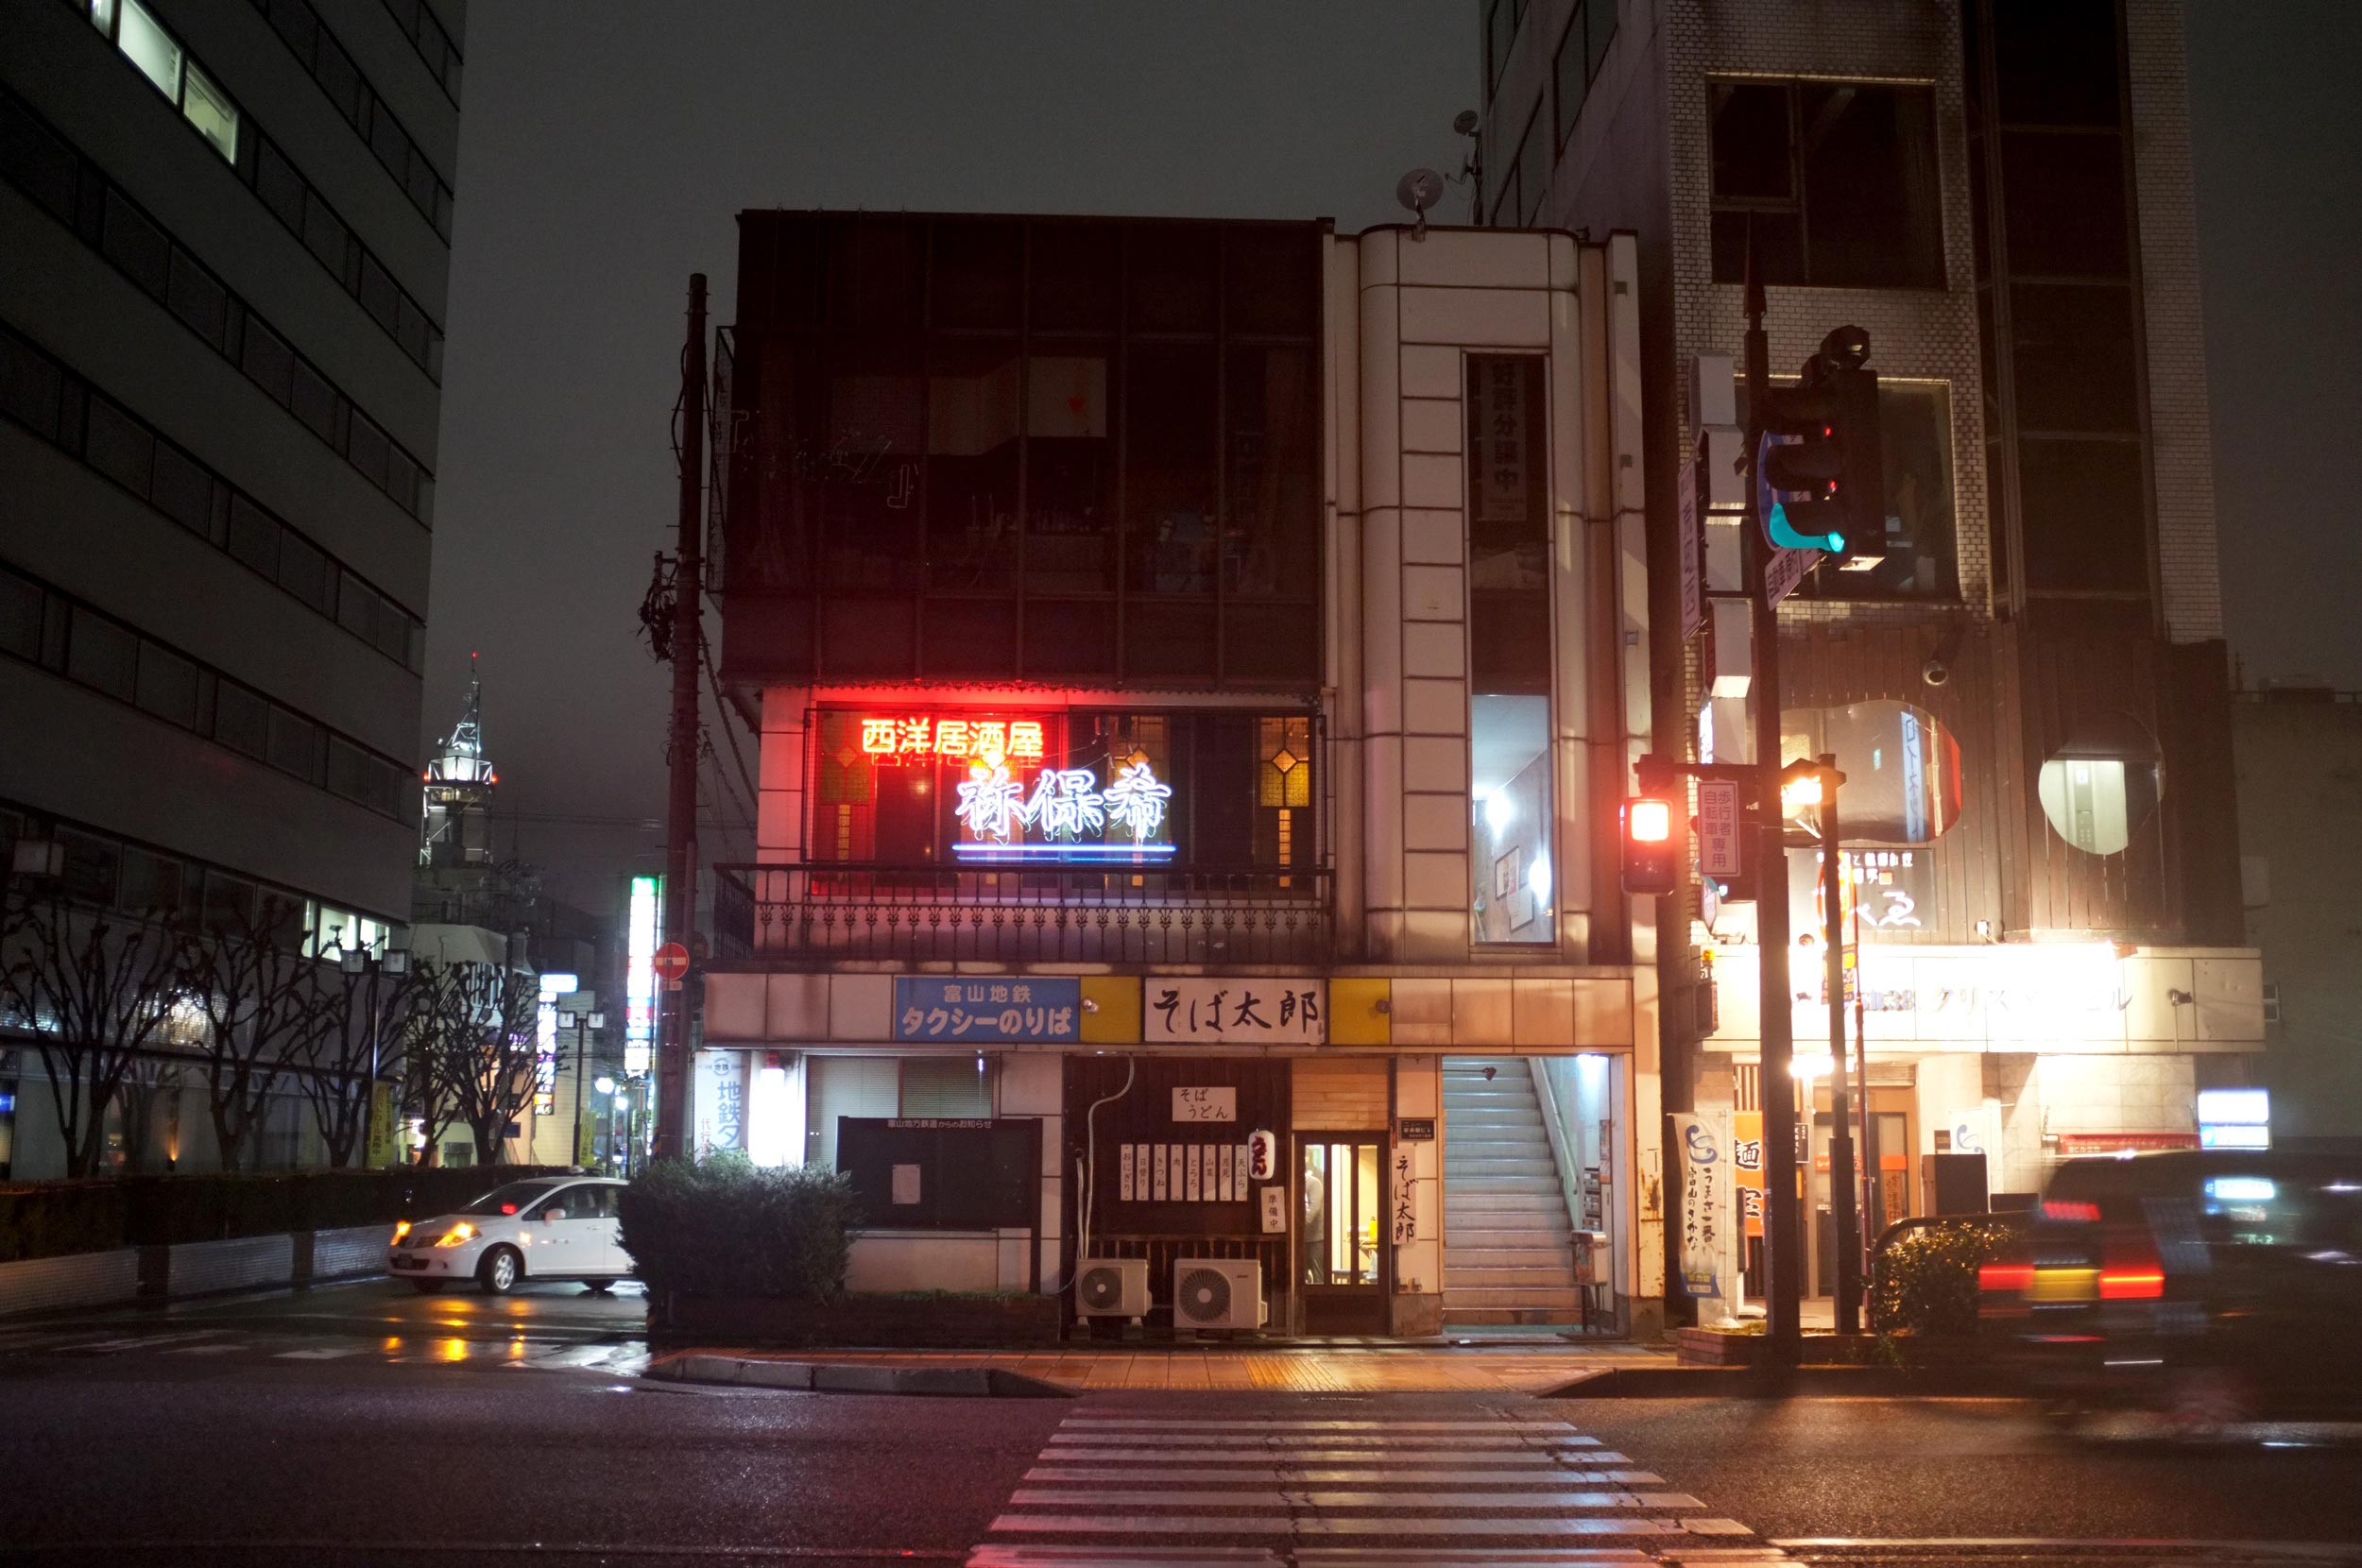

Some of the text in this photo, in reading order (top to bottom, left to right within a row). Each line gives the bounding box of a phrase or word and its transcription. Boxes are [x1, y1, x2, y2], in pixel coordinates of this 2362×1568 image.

[861, 716, 1044, 758] 西洋居酒屋
[1703, 791, 1719, 836] 自転車
[1718, 791, 1732, 836] 歩行者
[1711, 838, 1727, 868] 専用
[943, 983, 1032, 1004] 富山地鉄
[1931, 985, 2134, 1013] クリスル
[901, 1005, 1072, 1038] タクシーのりば
[1153, 988, 1320, 1035] そば太郎
[1180, 1088, 1208, 1102] そば
[716, 1080, 742, 1150] 地鉄タ
[1188, 1105, 1229, 1119] うどん
[1172, 1158, 1181, 1167] 肉
[1206, 1159, 1214, 1177] 山菜
[1222, 1158, 1230, 1178] 月見
[1251, 1135, 1268, 1176] うどん
[1122, 1152, 1132, 1191] おにぎり
[1156, 1158, 1166, 1187] きつね
[1238, 1158, 1246, 1188] 天ぷら
[1267, 1193, 1279, 1229] 準備中
[1394, 1154, 1419, 1243] そば太郎
